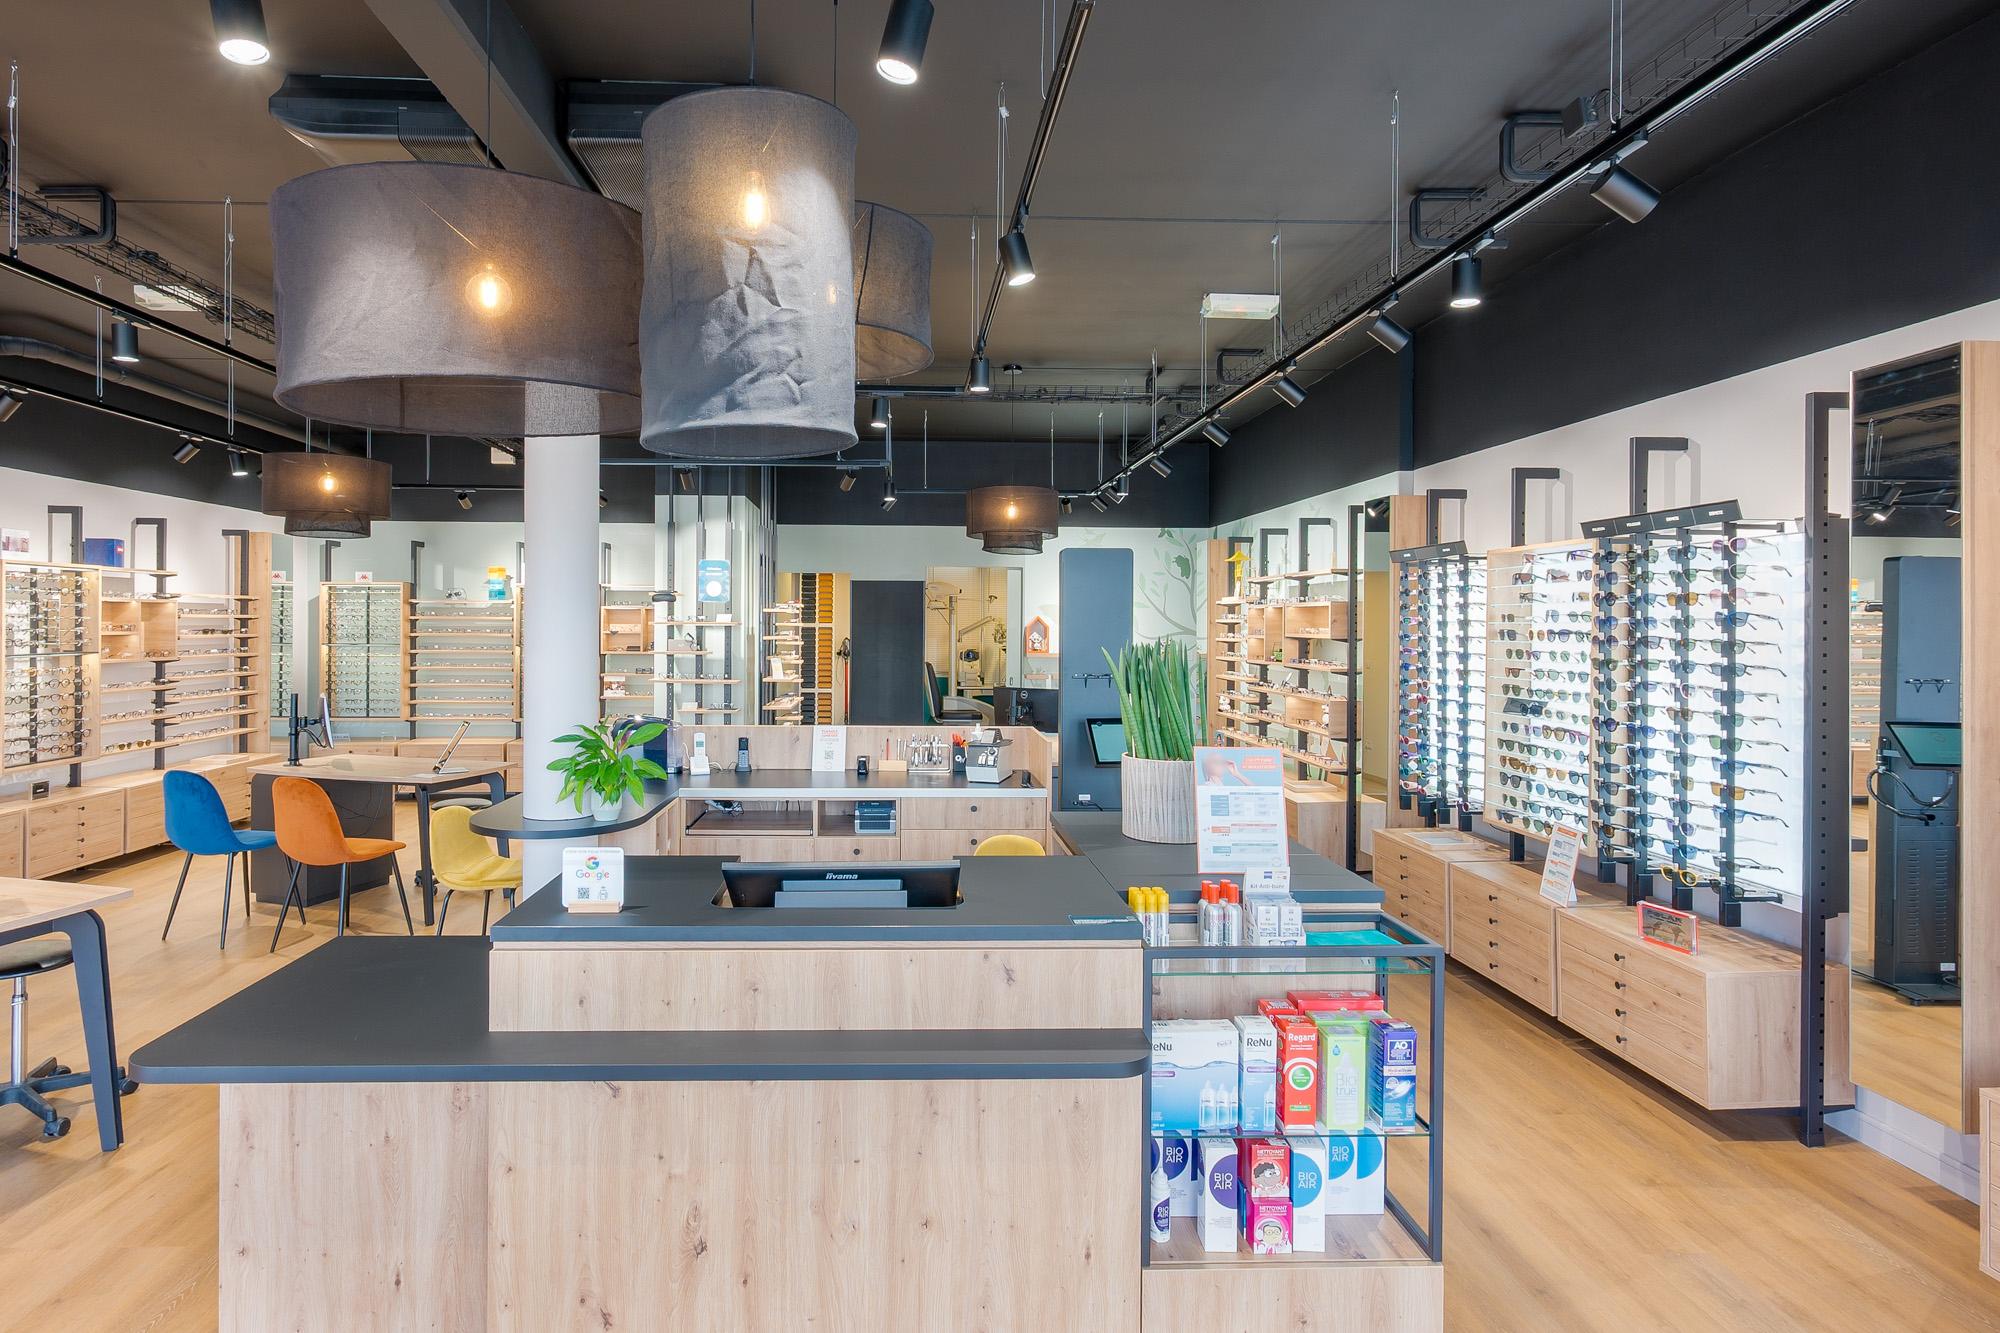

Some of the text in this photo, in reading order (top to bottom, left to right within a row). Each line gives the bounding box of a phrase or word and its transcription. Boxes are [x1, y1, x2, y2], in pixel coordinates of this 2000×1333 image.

[575, 869, 610, 881] Google
[1246, 1037, 1272, 1047] ReNu
[1288, 1033, 1316, 1043] Regard
[1152, 1042, 1173, 1052] eNu
[1394, 1041, 1408, 1050] AO
[1165, 1147, 1184, 1155] BIO
[1332, 1146, 1350, 1154] BIO
[1165, 1154, 1184, 1163] AIR
[1331, 1154, 1349, 1162] AIR
[1214, 1173, 1233, 1182] BIO
[1298, 1172, 1317, 1181] BIO
[1213, 1182, 1233, 1190] AIR
[1298, 1180, 1317, 1189] AIR
